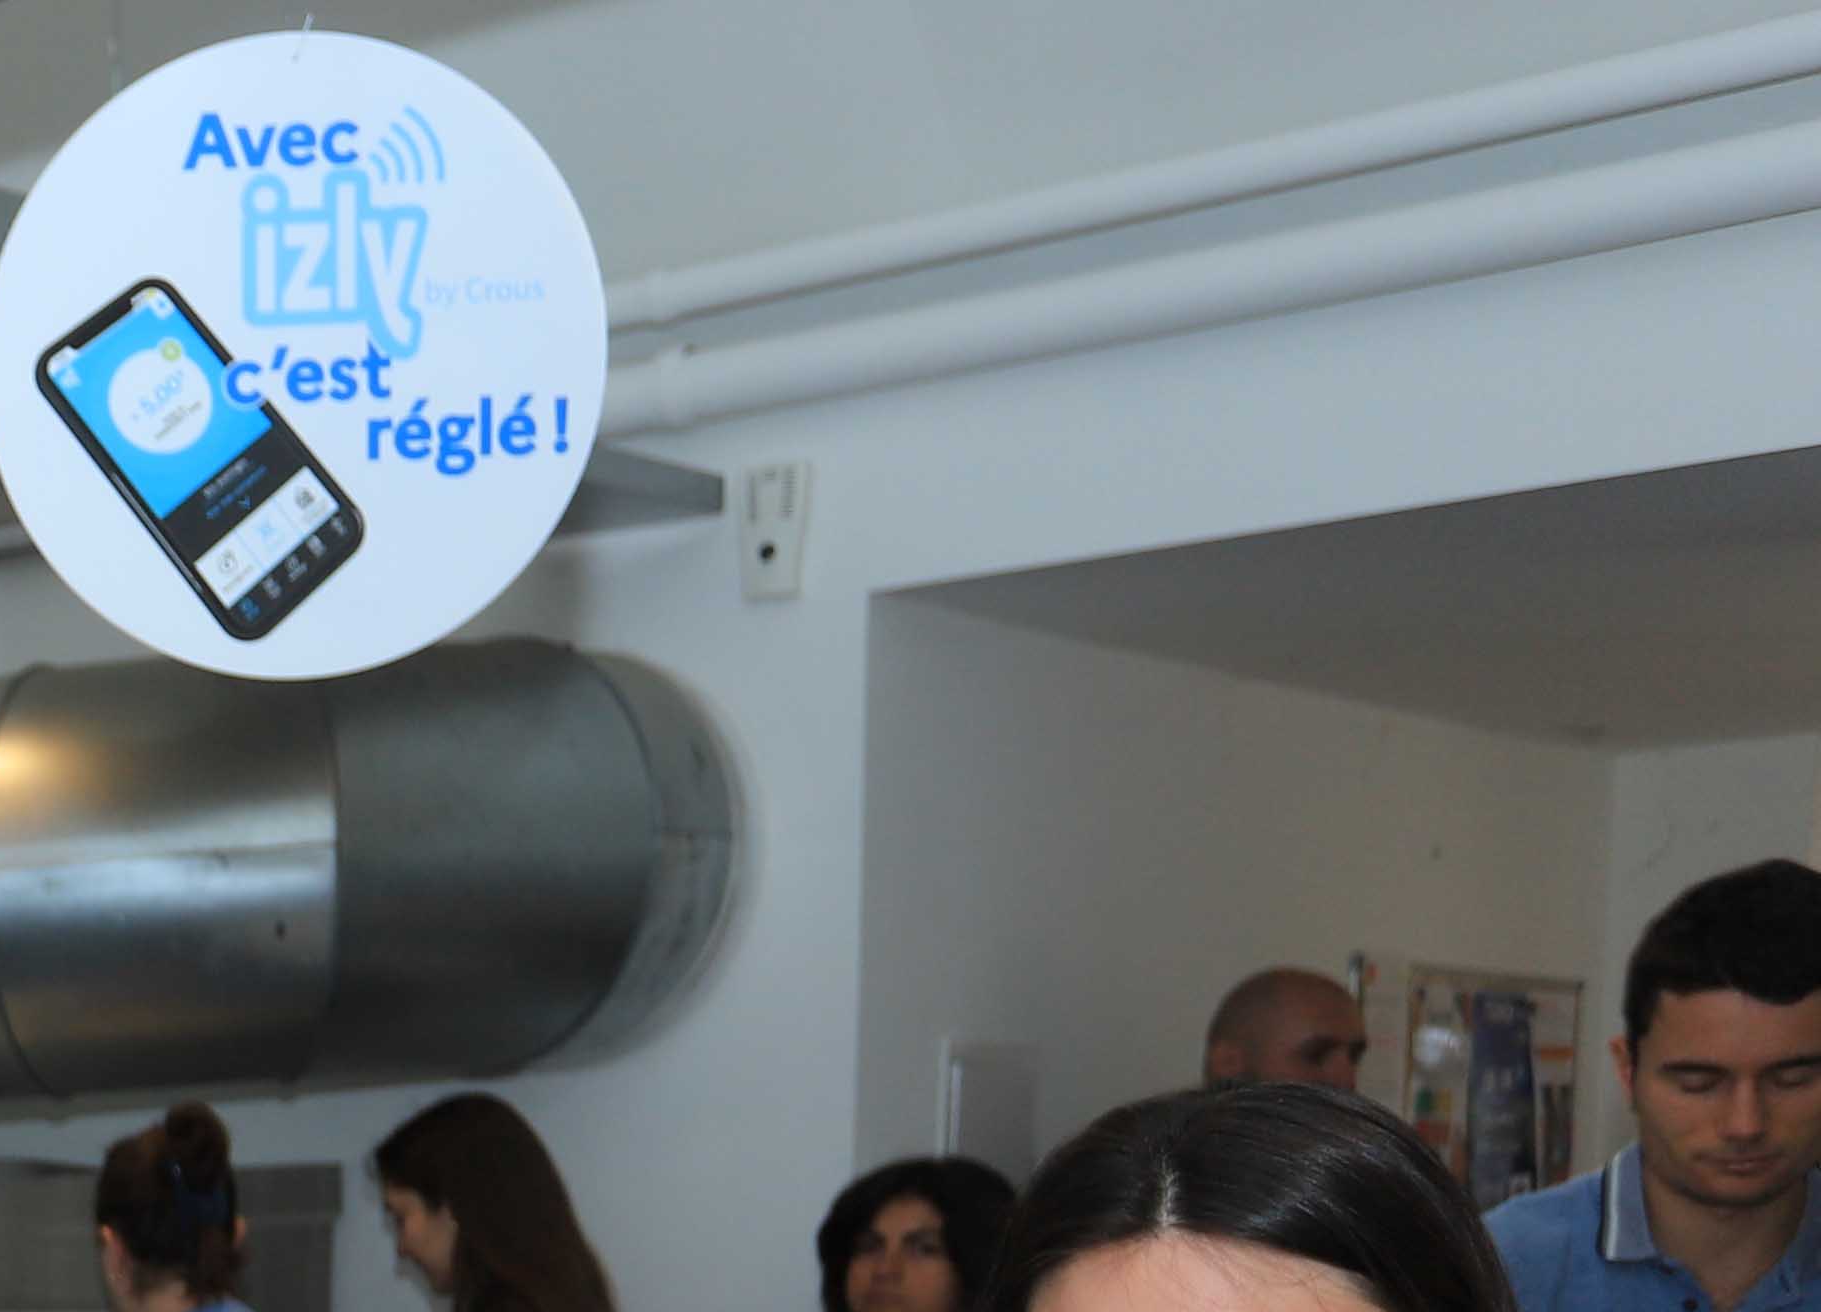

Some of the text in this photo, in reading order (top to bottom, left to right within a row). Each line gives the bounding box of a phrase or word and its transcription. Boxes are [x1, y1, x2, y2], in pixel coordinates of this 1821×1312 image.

[183, 113, 361, 170] Avec
[240, 169, 429, 359] izly
[225, 343, 393, 403] c'est
[365, 395, 537, 477] réglé
